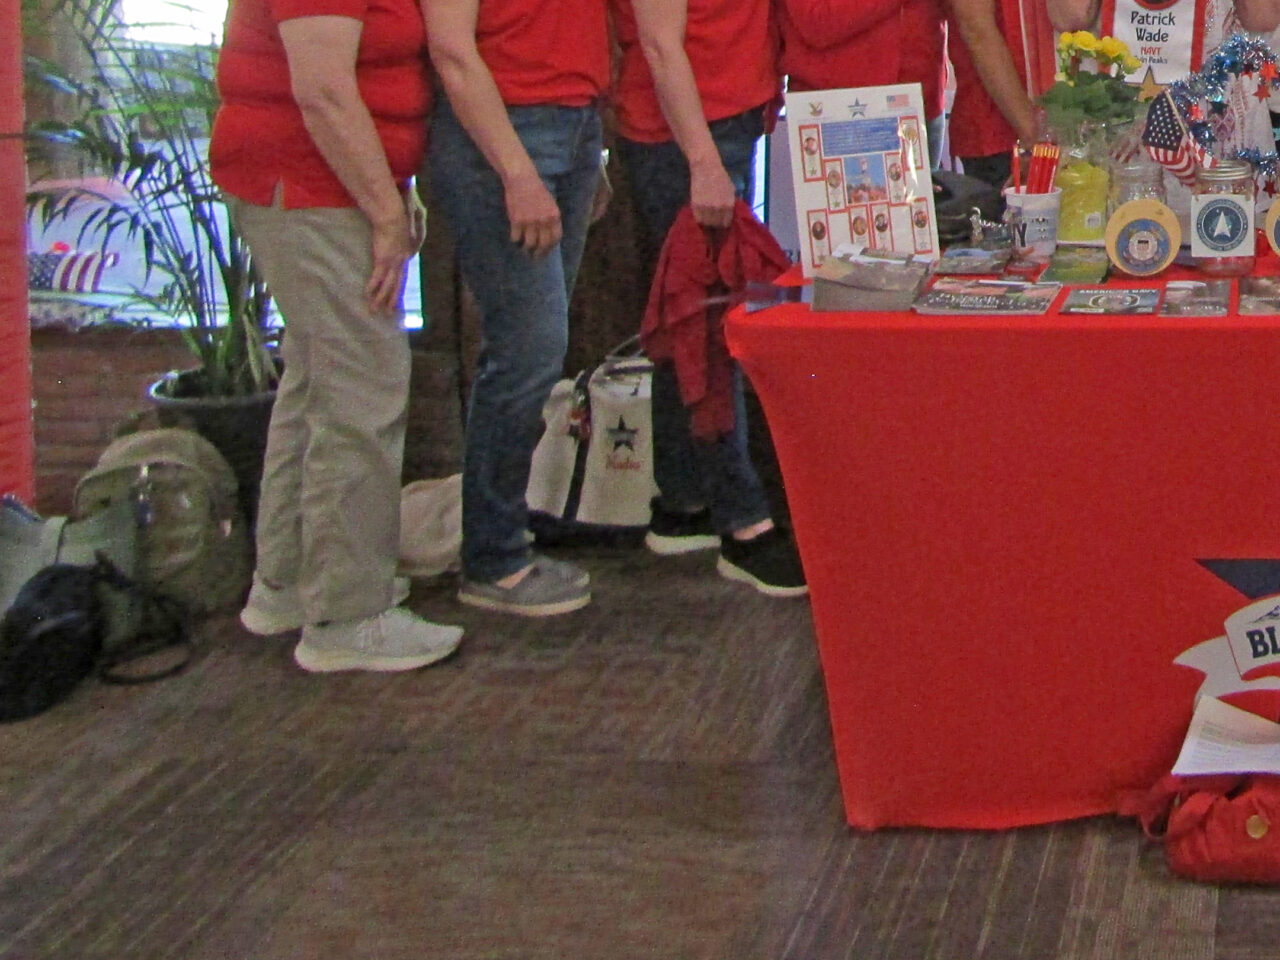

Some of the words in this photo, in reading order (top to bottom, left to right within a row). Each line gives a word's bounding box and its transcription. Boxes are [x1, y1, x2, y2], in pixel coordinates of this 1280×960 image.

[1130, 10, 1176, 26] Patrick
[1135, 27, 1169, 43] Wade
[1140, 46, 1162, 55] NAVY
